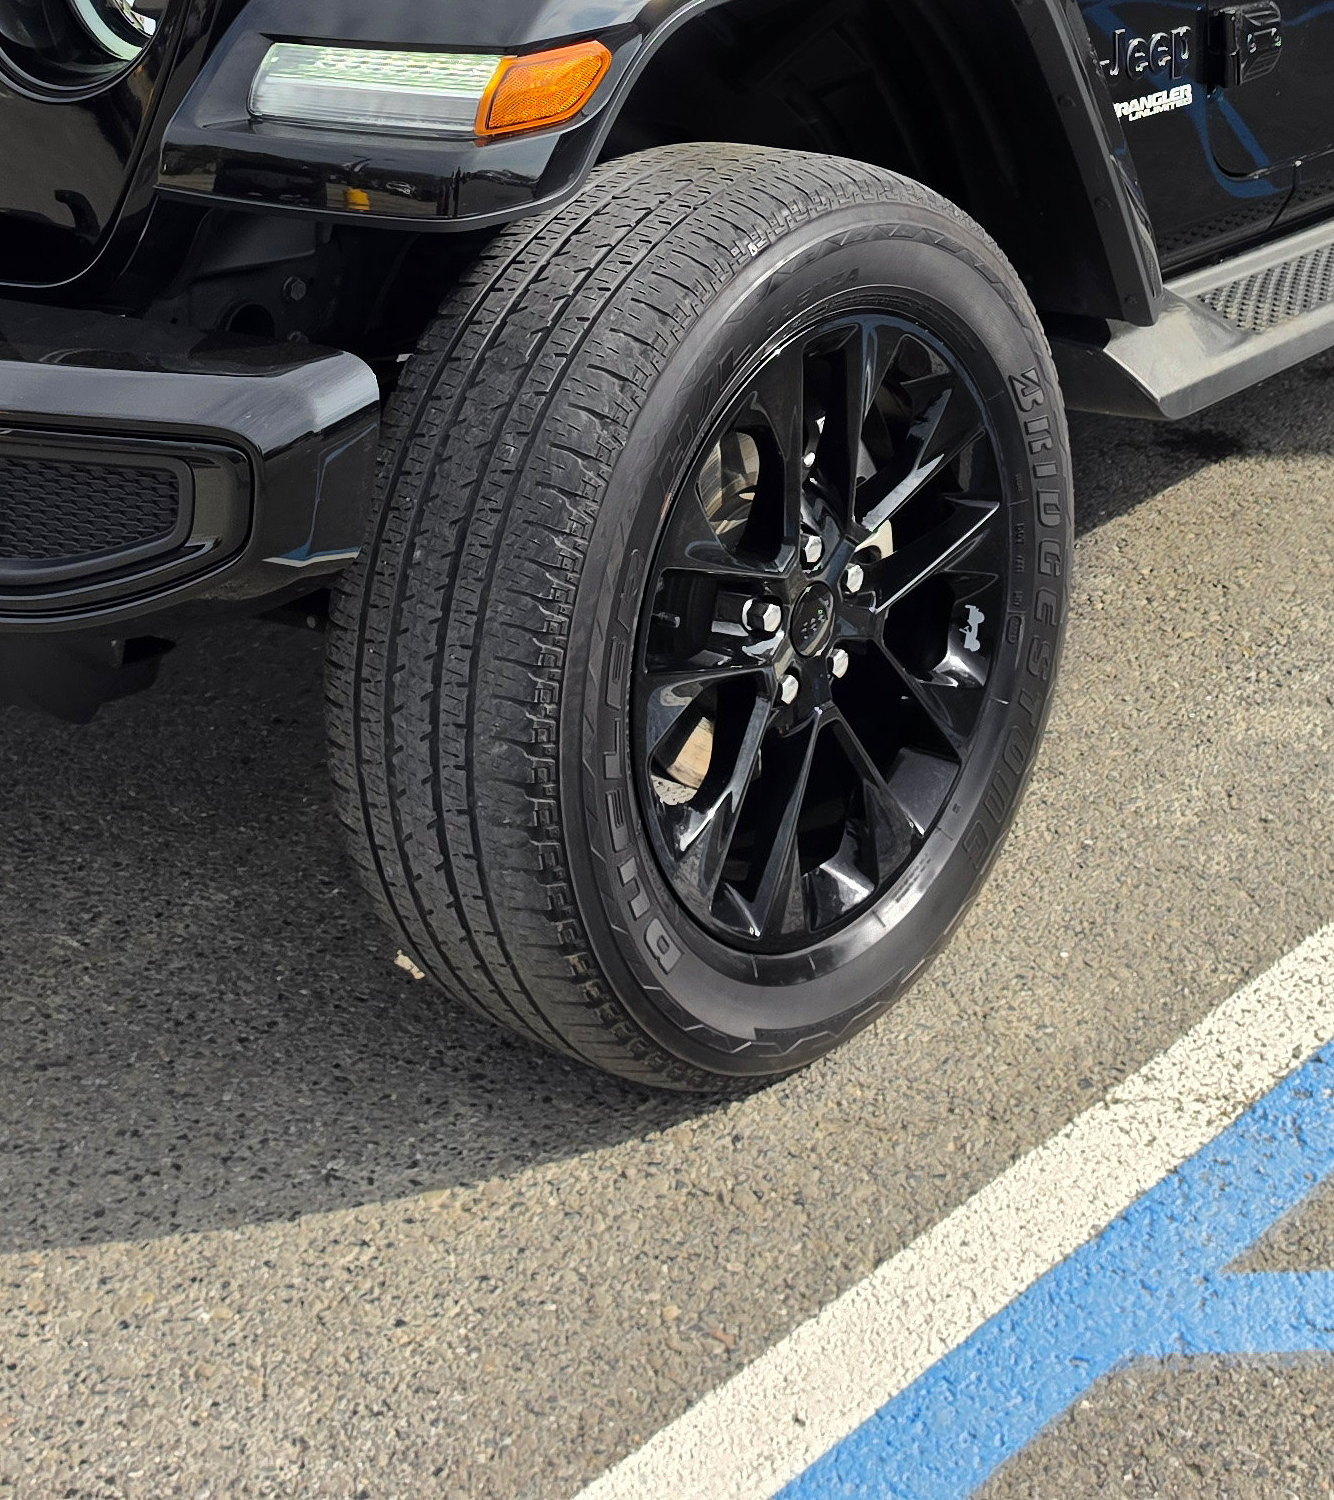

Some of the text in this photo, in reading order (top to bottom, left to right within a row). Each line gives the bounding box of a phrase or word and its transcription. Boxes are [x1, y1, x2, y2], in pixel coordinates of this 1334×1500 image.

[1098, 25, 1192, 81] Jeep
[1128, 97, 1193, 122] UNLIMITED
[964, 367, 1065, 870] BRIDGESTONE
[603, 548, 685, 976] DUELER
